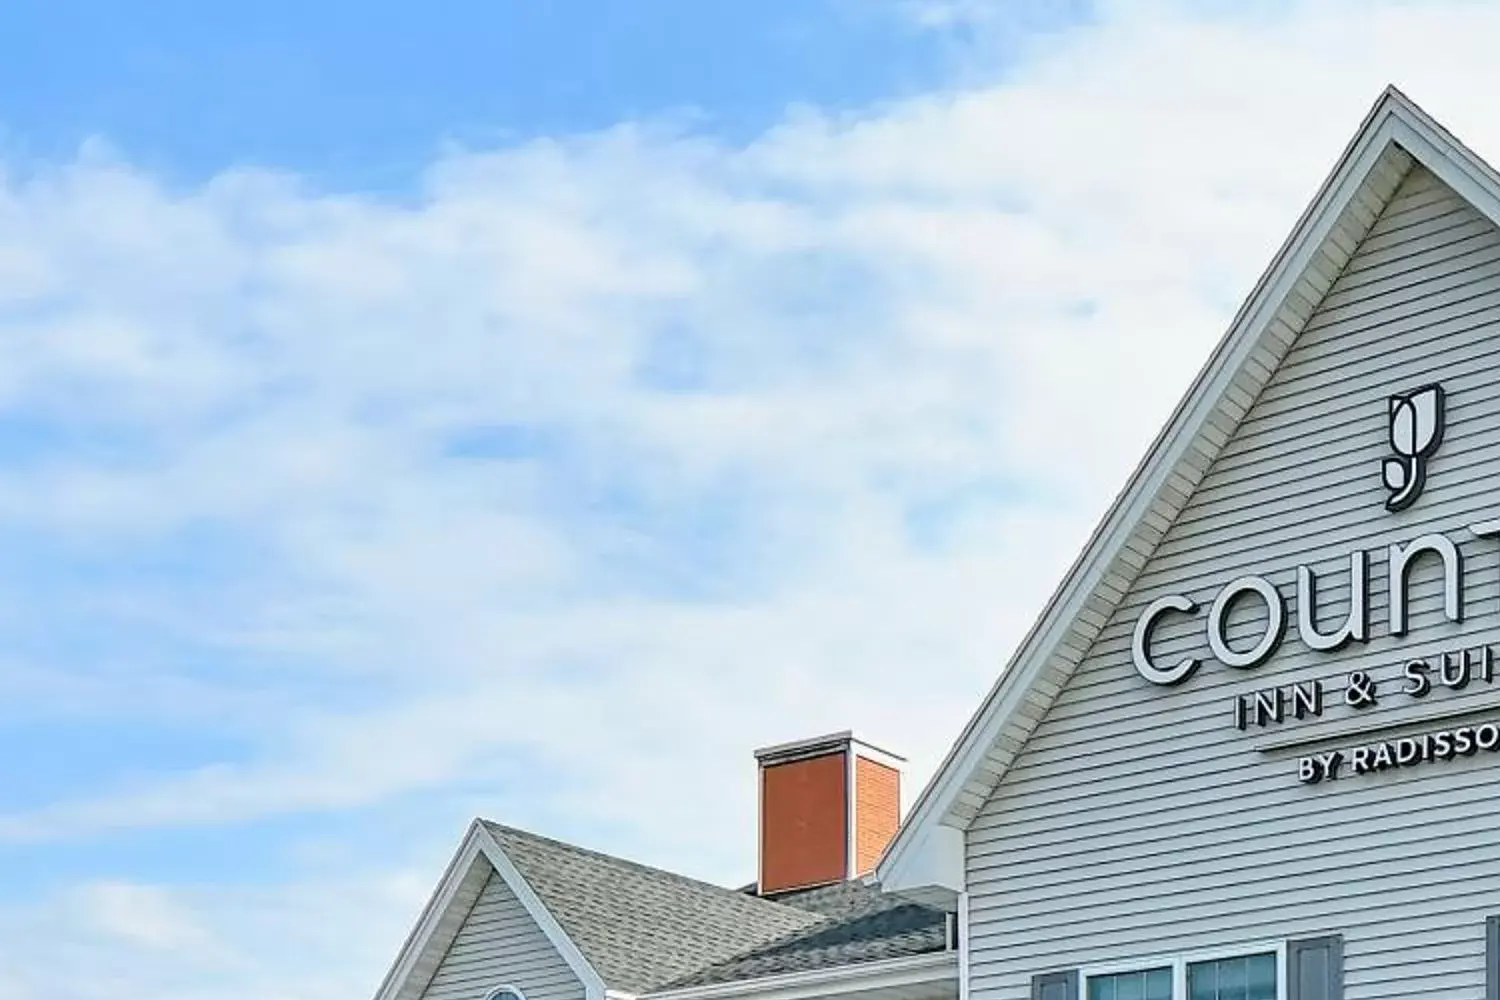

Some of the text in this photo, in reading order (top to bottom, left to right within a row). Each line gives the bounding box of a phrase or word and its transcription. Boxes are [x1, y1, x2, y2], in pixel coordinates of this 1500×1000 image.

[1234, 680, 1322, 730] INN
[1345, 671, 1376, 708] &
[1299, 752, 1343, 784] BY
